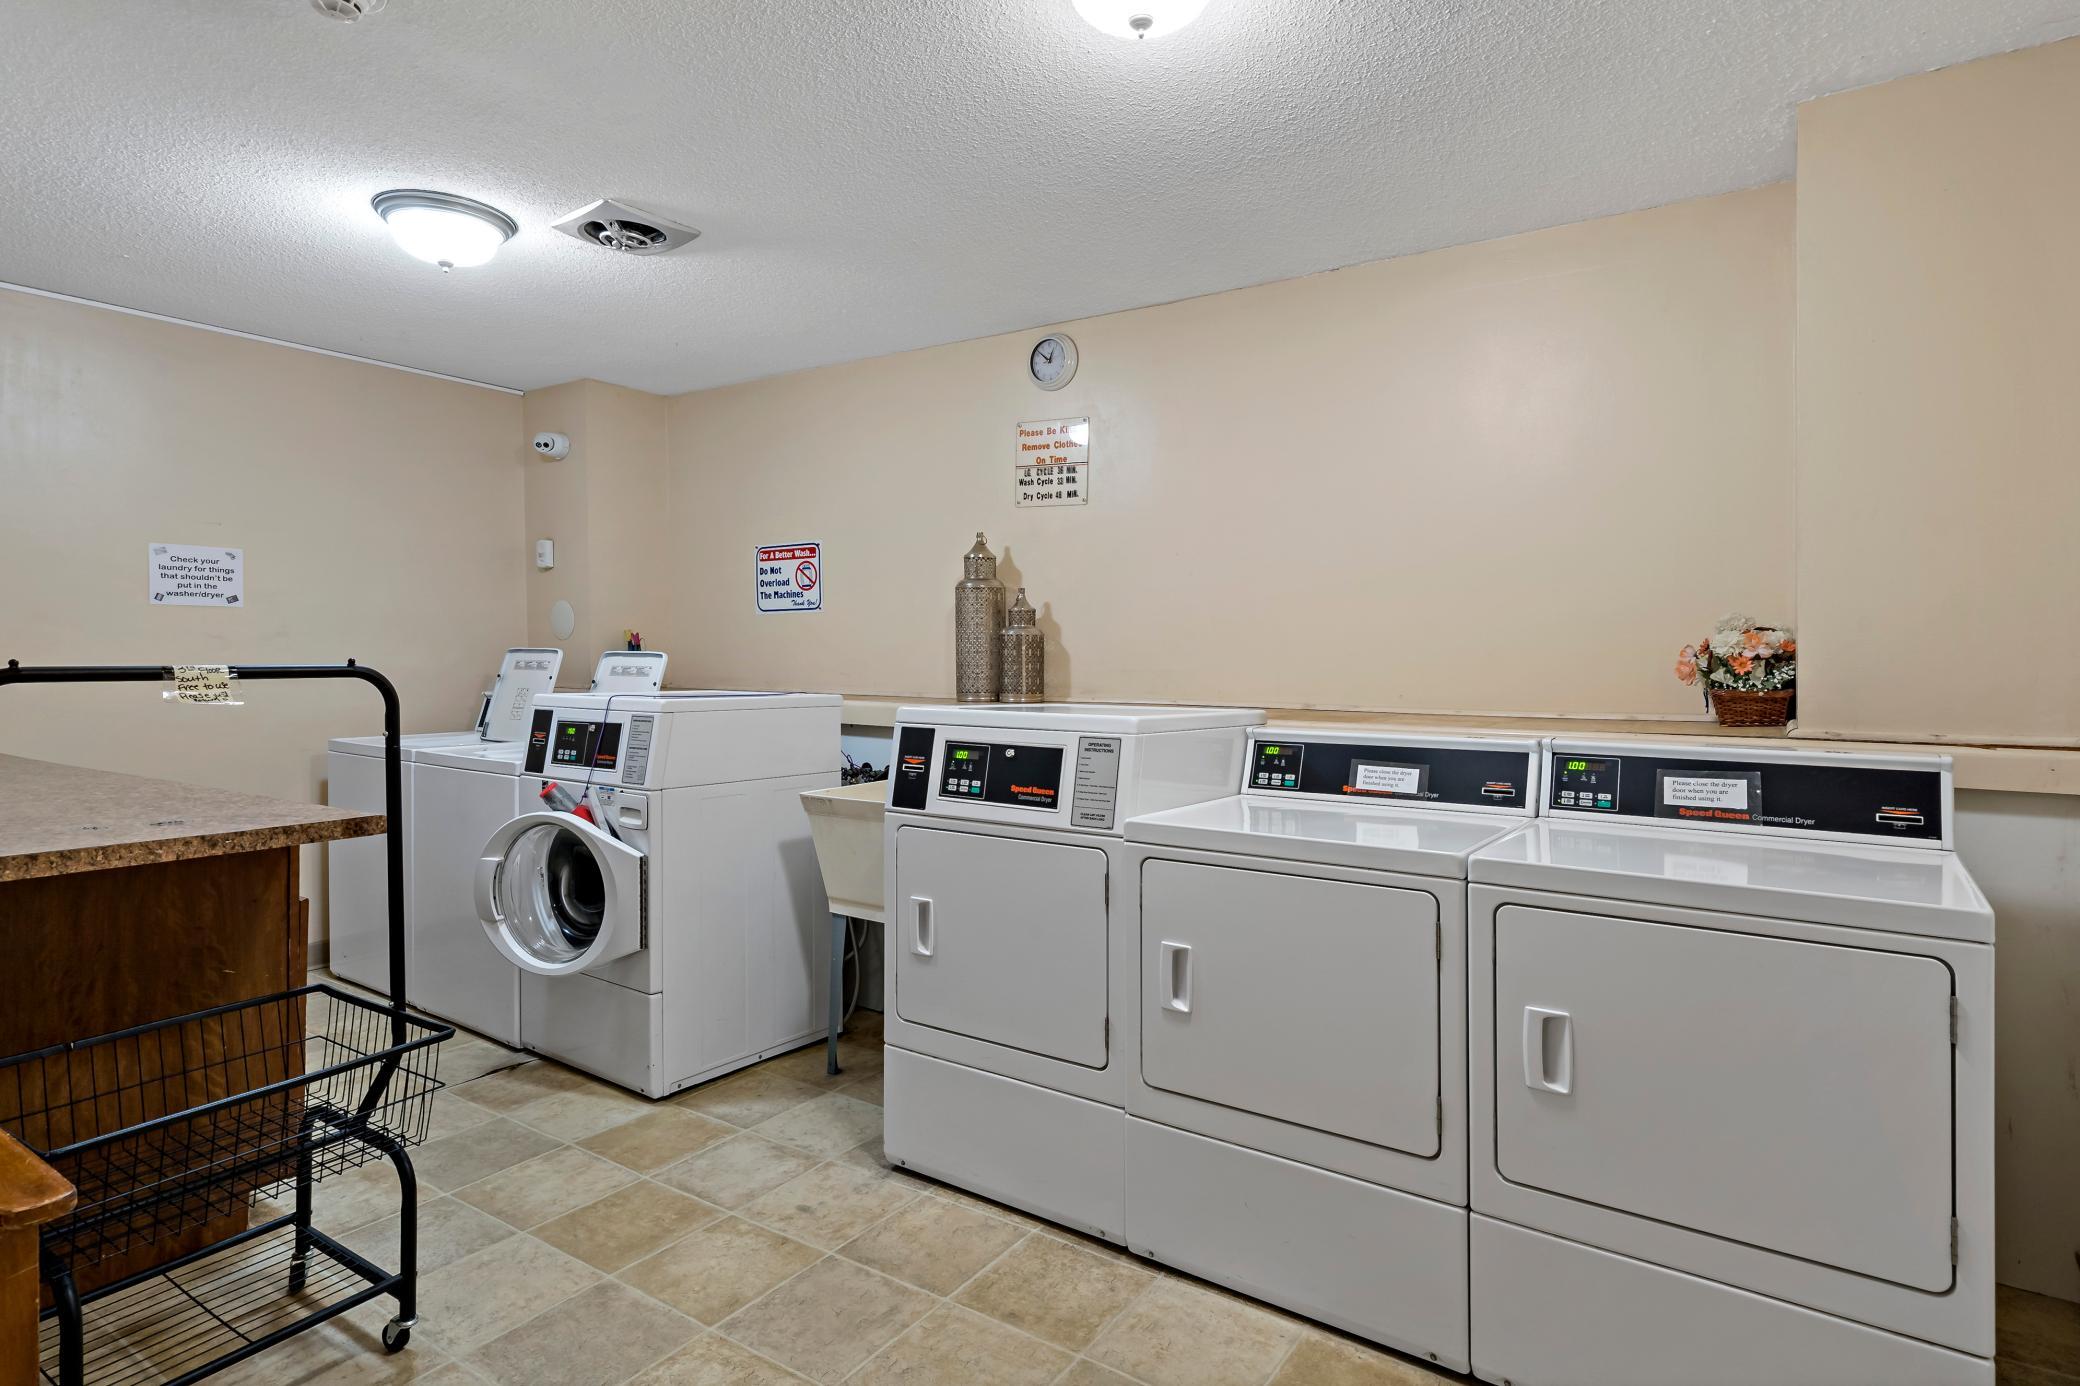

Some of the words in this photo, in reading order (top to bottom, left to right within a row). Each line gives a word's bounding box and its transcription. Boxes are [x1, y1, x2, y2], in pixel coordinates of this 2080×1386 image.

[1019, 429, 1043, 437] Please
[1046, 427, 1056, 435] Be
[1022, 443, 1050, 451] Remove
[1050, 455, 1068, 463] Time
[1019, 478, 1034, 486] Wash
[1036, 478, 1054, 487] Cycle
[1023, 492, 1033, 501] Dry
[1036, 492, 1053, 501] Cycle
[170, 555, 198, 563] Check
[158, 564, 192, 573] laundry
[209, 566, 235, 575] things
[770, 566, 782, 575] Not
[160, 572, 178, 580] that
[180, 574, 221, 582] shouldn't
[177, 582, 192, 590] put
[760, 578, 790, 587] Overload
[166, 590, 224, 600] washer/dryer
[760, 592, 772, 600] The
[773, 590, 804, 599] Machines
[1679, 808, 1713, 817] Speed
[1714, 809, 1750, 820] Queen
[1752, 813, 1794, 824] Commercial
[1795, 816, 1816, 826] Dryer
